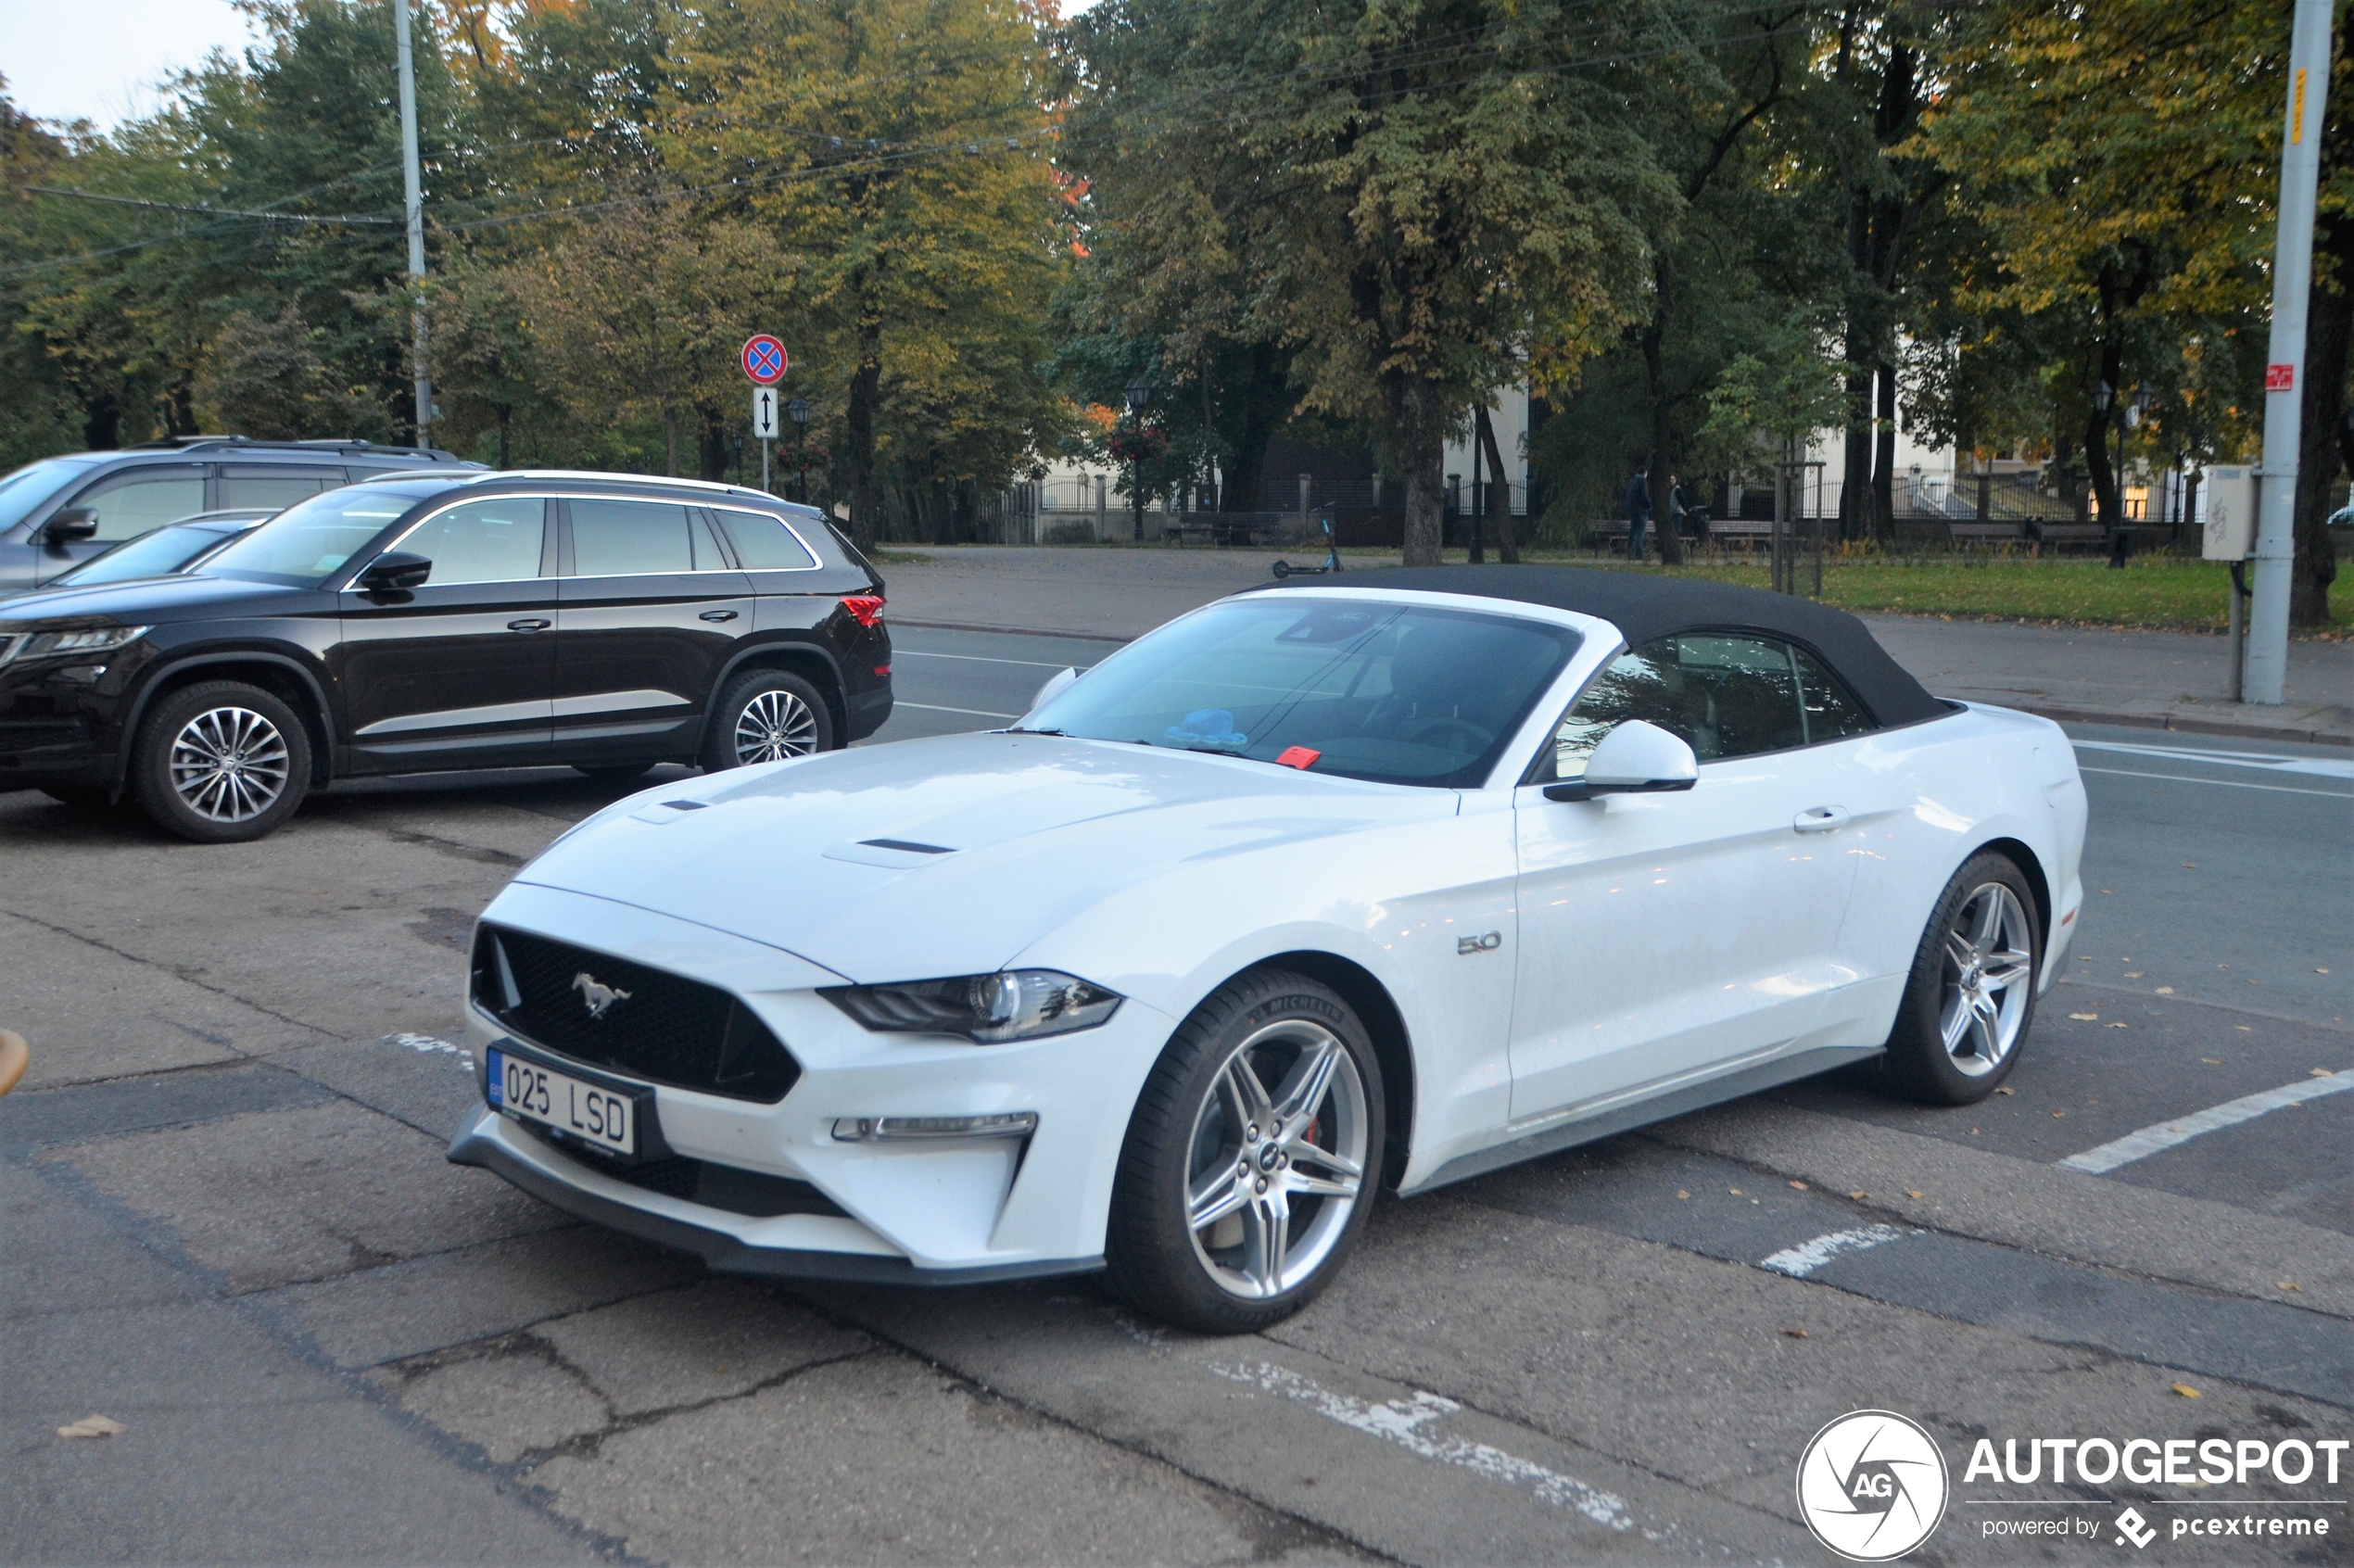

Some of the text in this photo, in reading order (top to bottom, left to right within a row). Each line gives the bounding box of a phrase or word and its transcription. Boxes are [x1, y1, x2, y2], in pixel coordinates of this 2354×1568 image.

[1270, 995, 1343, 1022] MICHELIN
[508, 1062, 624, 1142] 025 LSD
